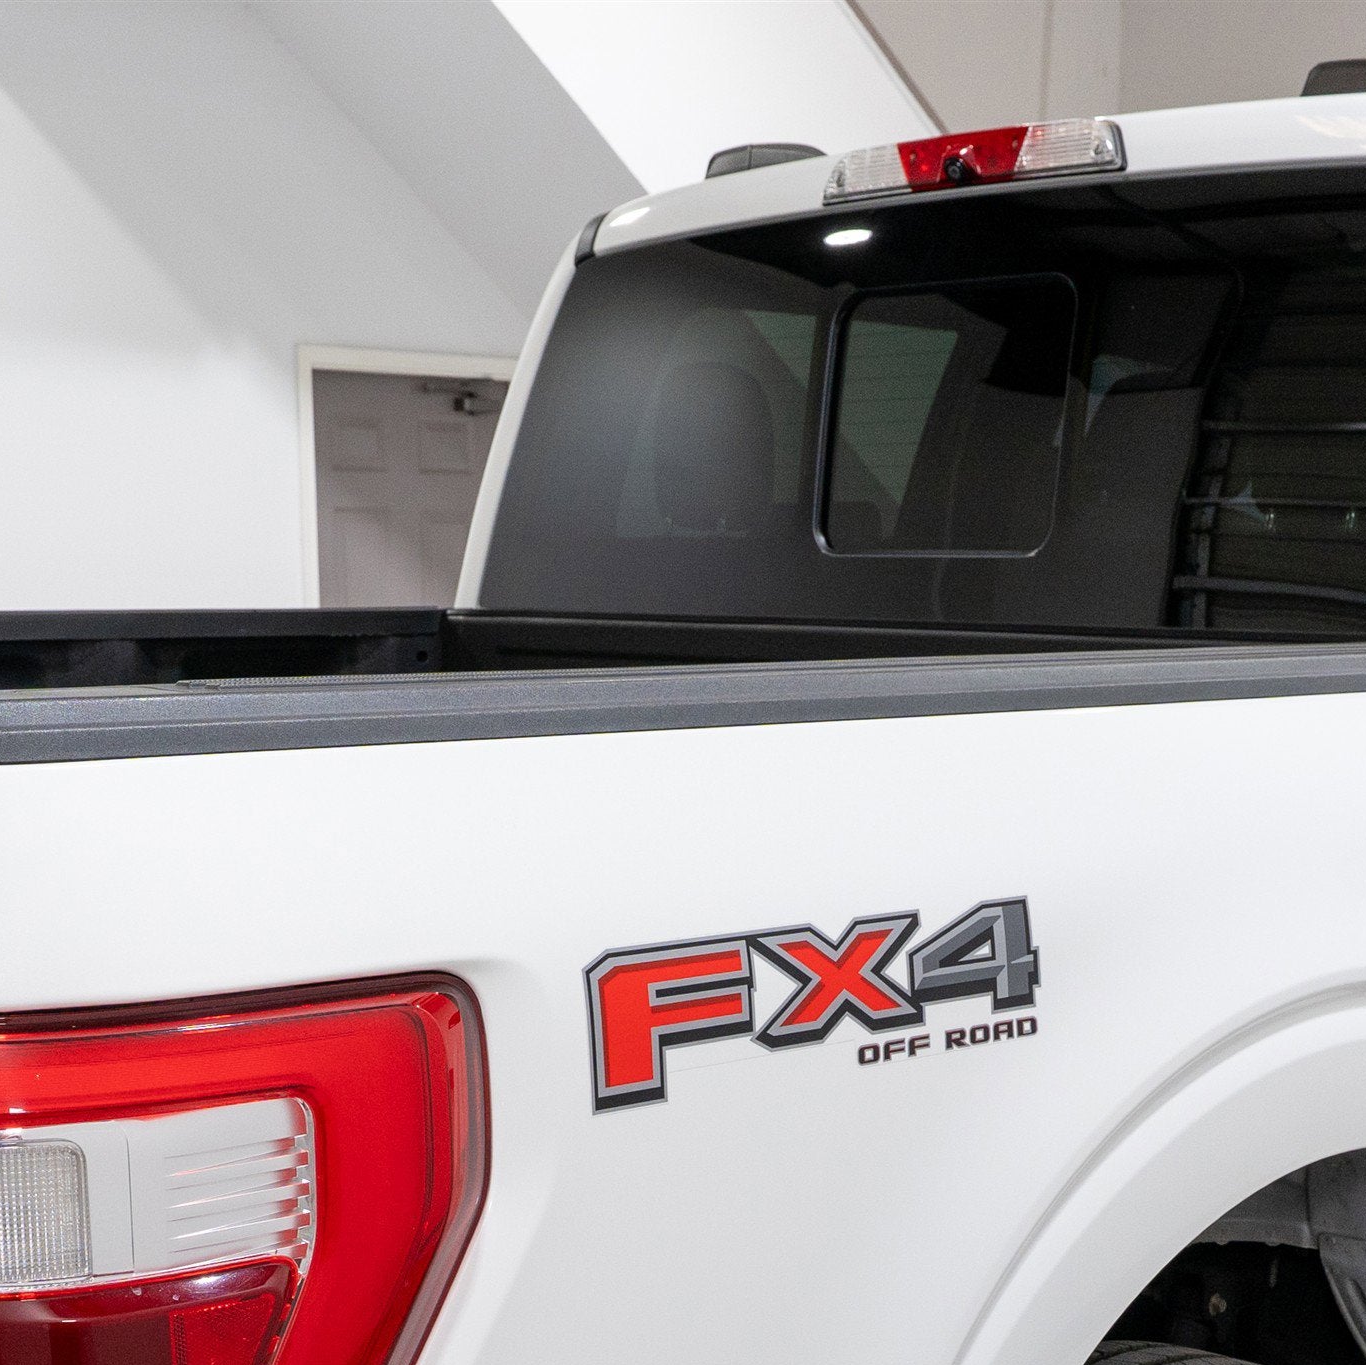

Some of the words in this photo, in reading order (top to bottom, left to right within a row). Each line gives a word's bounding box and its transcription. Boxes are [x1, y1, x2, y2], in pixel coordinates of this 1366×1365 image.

[581, 894, 1041, 1116] FX4
[857, 1033, 931, 1067] OFF
[943, 1015, 1038, 1051] ROAD
